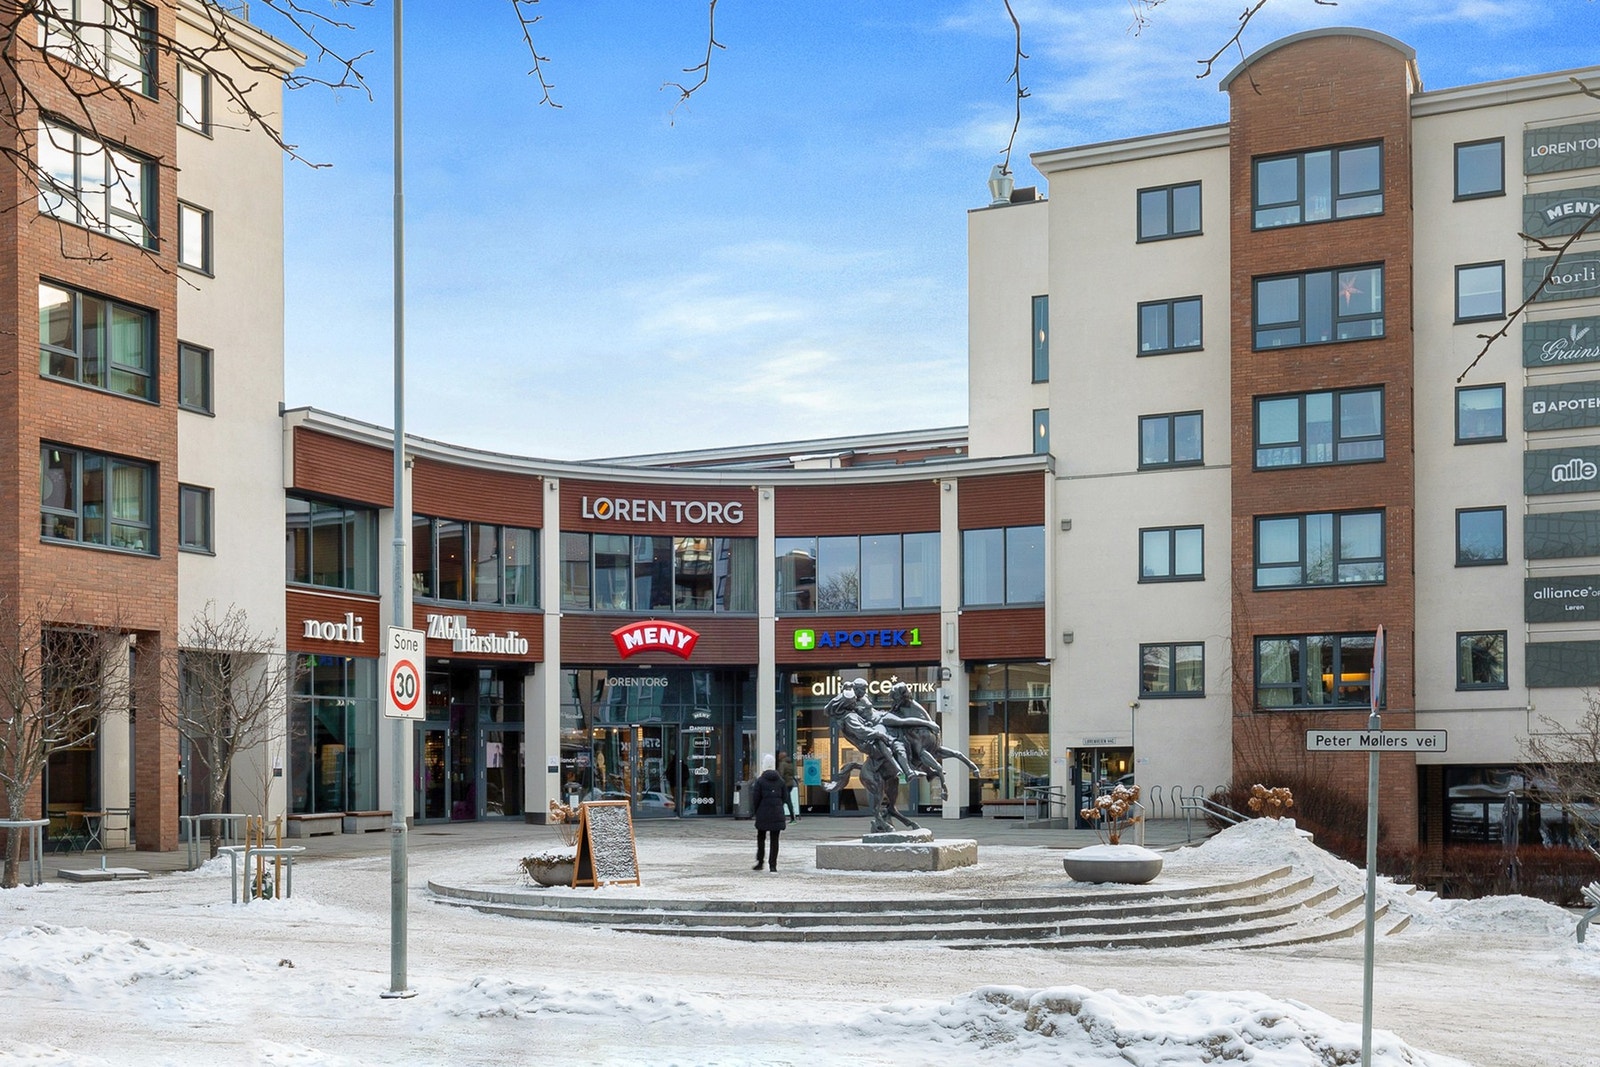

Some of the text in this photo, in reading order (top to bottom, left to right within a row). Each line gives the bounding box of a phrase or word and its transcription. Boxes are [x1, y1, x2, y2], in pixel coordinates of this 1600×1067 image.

[1578, 137, 1600, 151] TO
[1547, 202, 1600, 220] MENY
[1550, 267, 1596, 284] norli
[1552, 458, 1597, 483] nille
[671, 501, 744, 524] TORG
[303, 612, 365, 643] norli
[427, 614, 463, 640] ZAGA
[394, 633, 419, 652] Sone
[622, 627, 692, 651] MENY
[818, 631, 907, 648] APOTEK
[396, 672, 416, 699] 30
[640, 678, 669, 687] TORG
[1316, 735, 1436, 747] Peter Møllers vei
